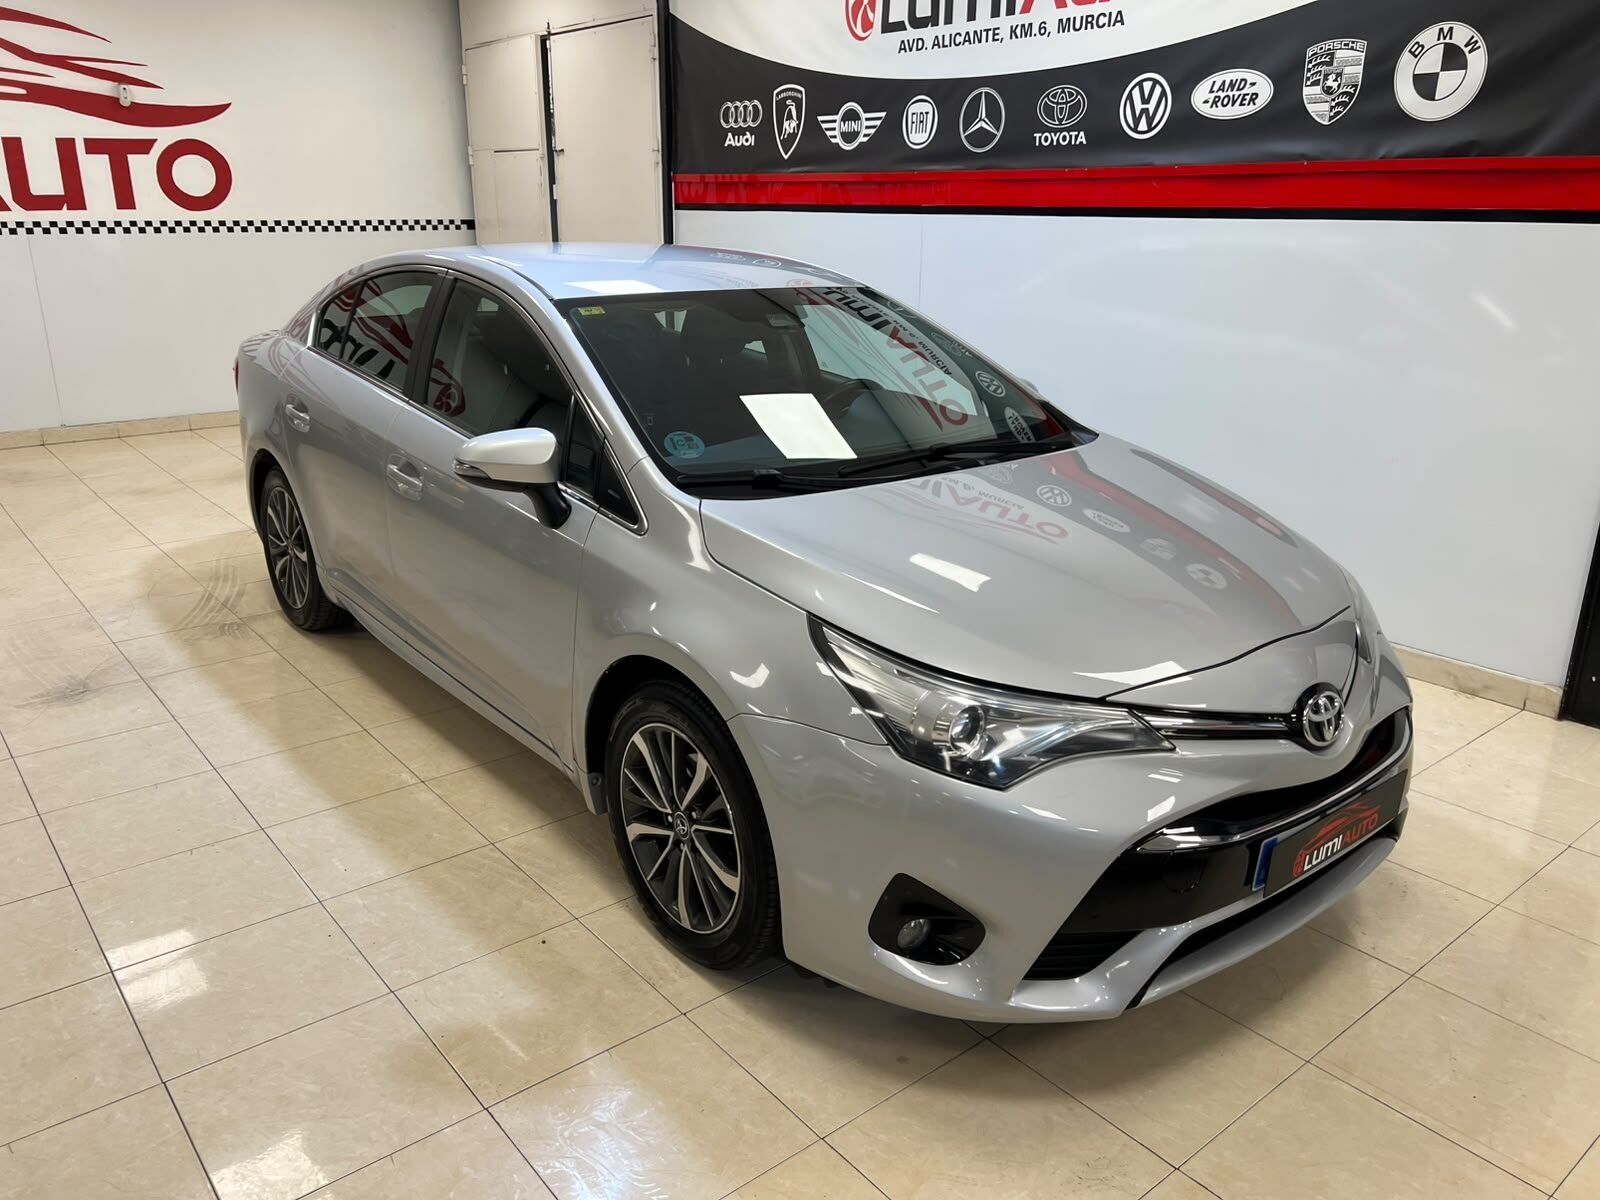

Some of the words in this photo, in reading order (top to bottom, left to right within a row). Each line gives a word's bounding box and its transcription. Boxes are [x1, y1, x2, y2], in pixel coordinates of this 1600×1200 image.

[898, 38, 928, 54] AVD.
[931, 27, 1004, 49] ALICANTE,
[1009, 20, 1051, 40] KM.6,
[1056, 10, 1125, 34] MURCIA
[1308, 41, 1364, 57] PORSCHE
[1408, 26, 1481, 59] BMW
[840, 120, 861, 133] MINI
[910, 111, 930, 135] FIAT
[724, 131, 755, 147] Audi
[1034, 131, 1087, 146] TOYOTA
[0, 136, 233, 212] UTO
